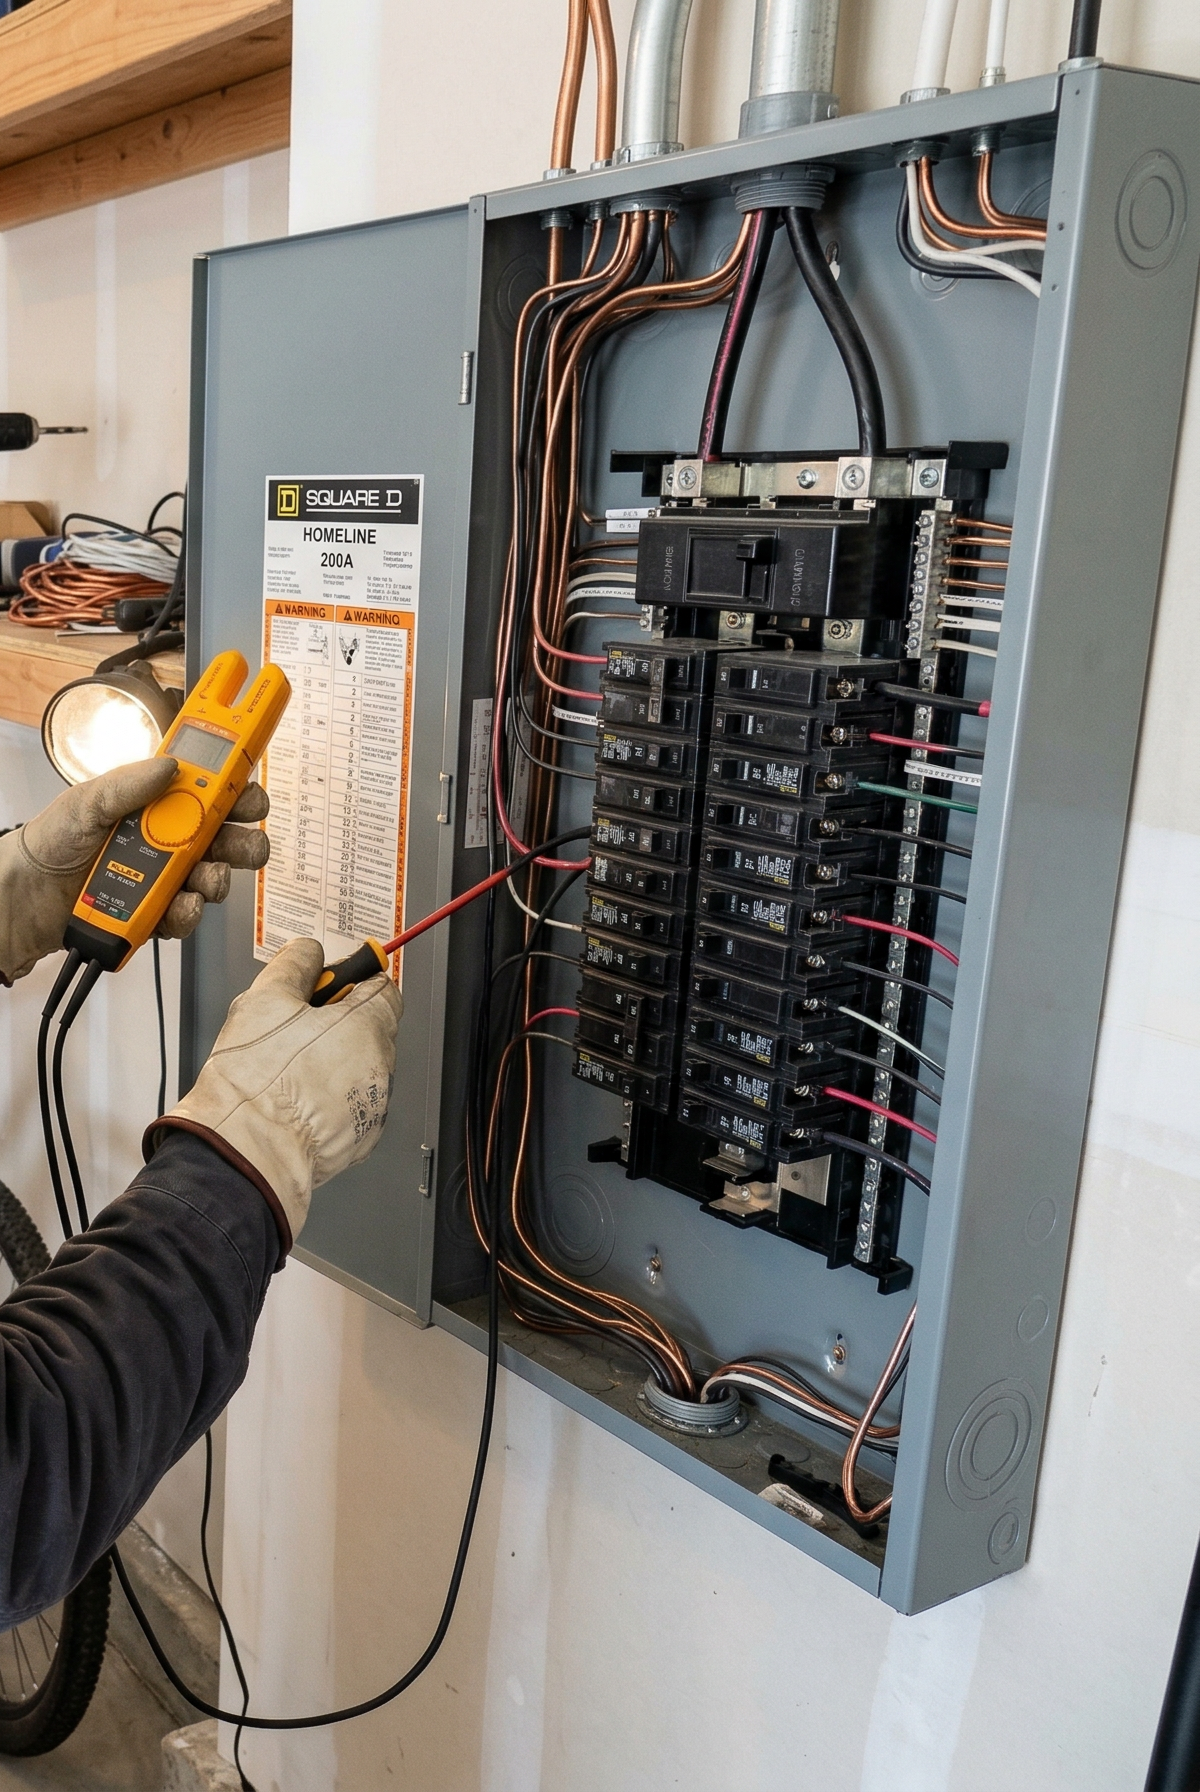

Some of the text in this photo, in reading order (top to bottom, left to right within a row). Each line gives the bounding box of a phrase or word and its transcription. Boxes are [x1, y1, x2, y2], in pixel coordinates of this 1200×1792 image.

[305, 489, 402, 506] SQUARE D
[303, 527, 377, 544] HOMELINE
[320, 552, 354, 568] 200A
[284, 603, 326, 618] WARNING
